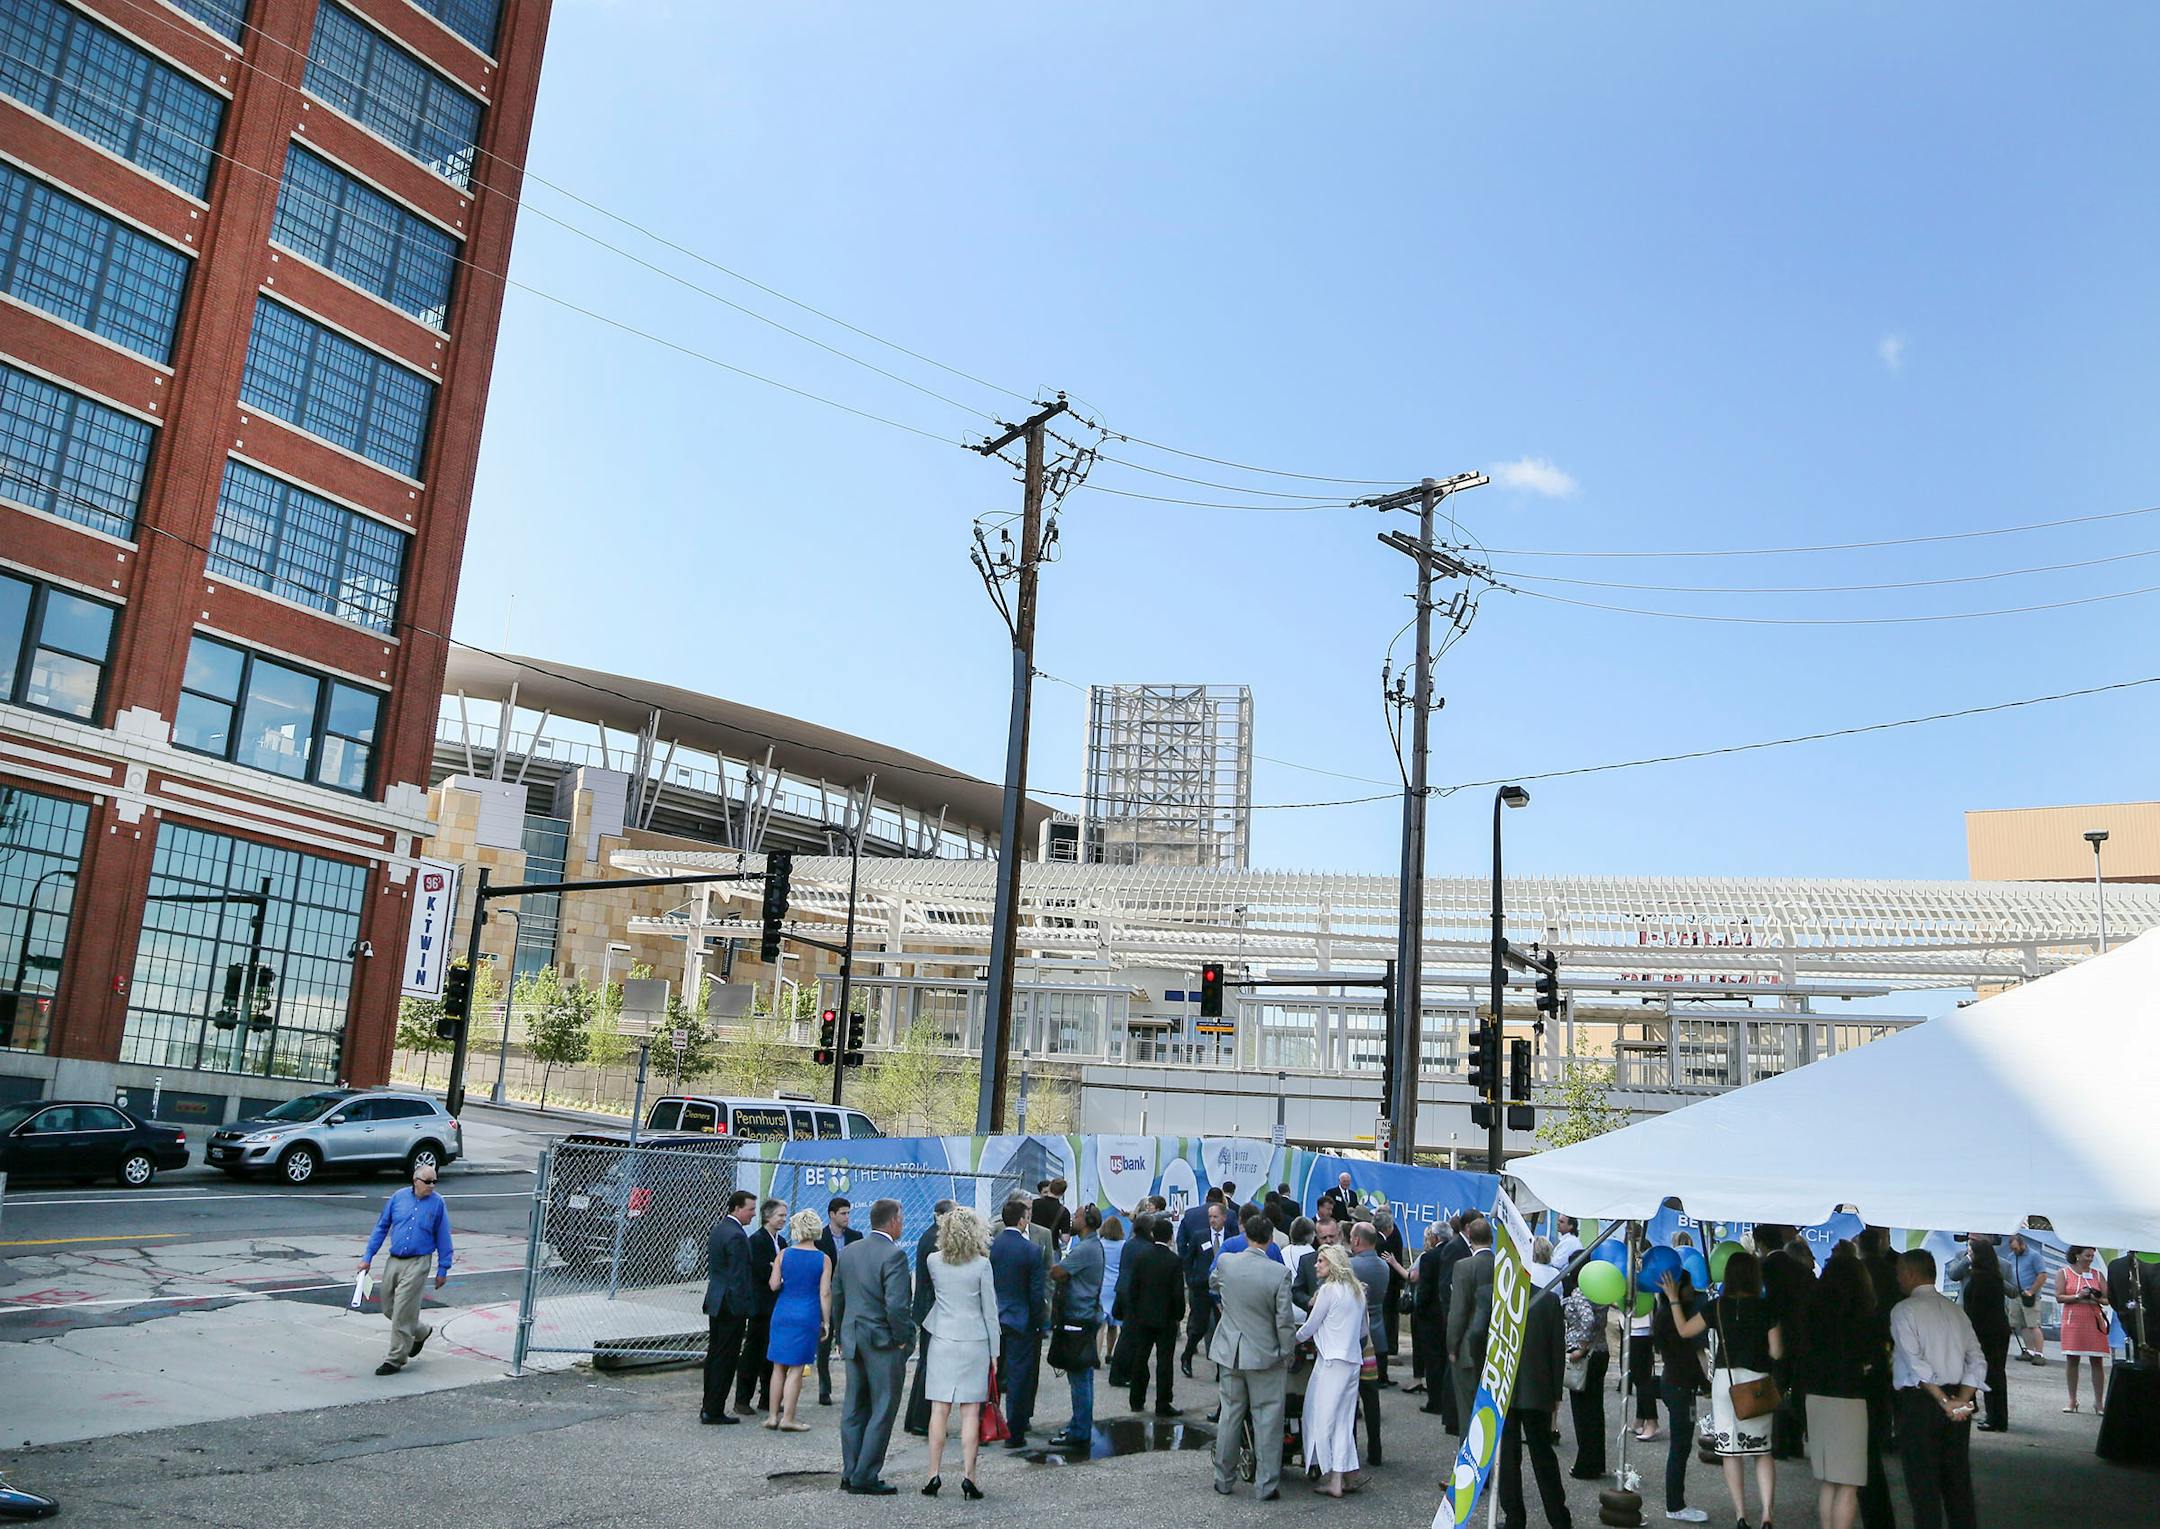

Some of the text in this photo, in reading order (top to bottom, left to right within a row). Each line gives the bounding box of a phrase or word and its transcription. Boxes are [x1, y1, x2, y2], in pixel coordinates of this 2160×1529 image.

[684, 1110, 710, 1120] Cleaners
[735, 1110, 786, 1126] Pennhurst
[805, 1162, 927, 1186] BE THE MATCH
[1391, 1201, 1435, 1223] THE
[1678, 1214, 1759, 1234] BE TH
